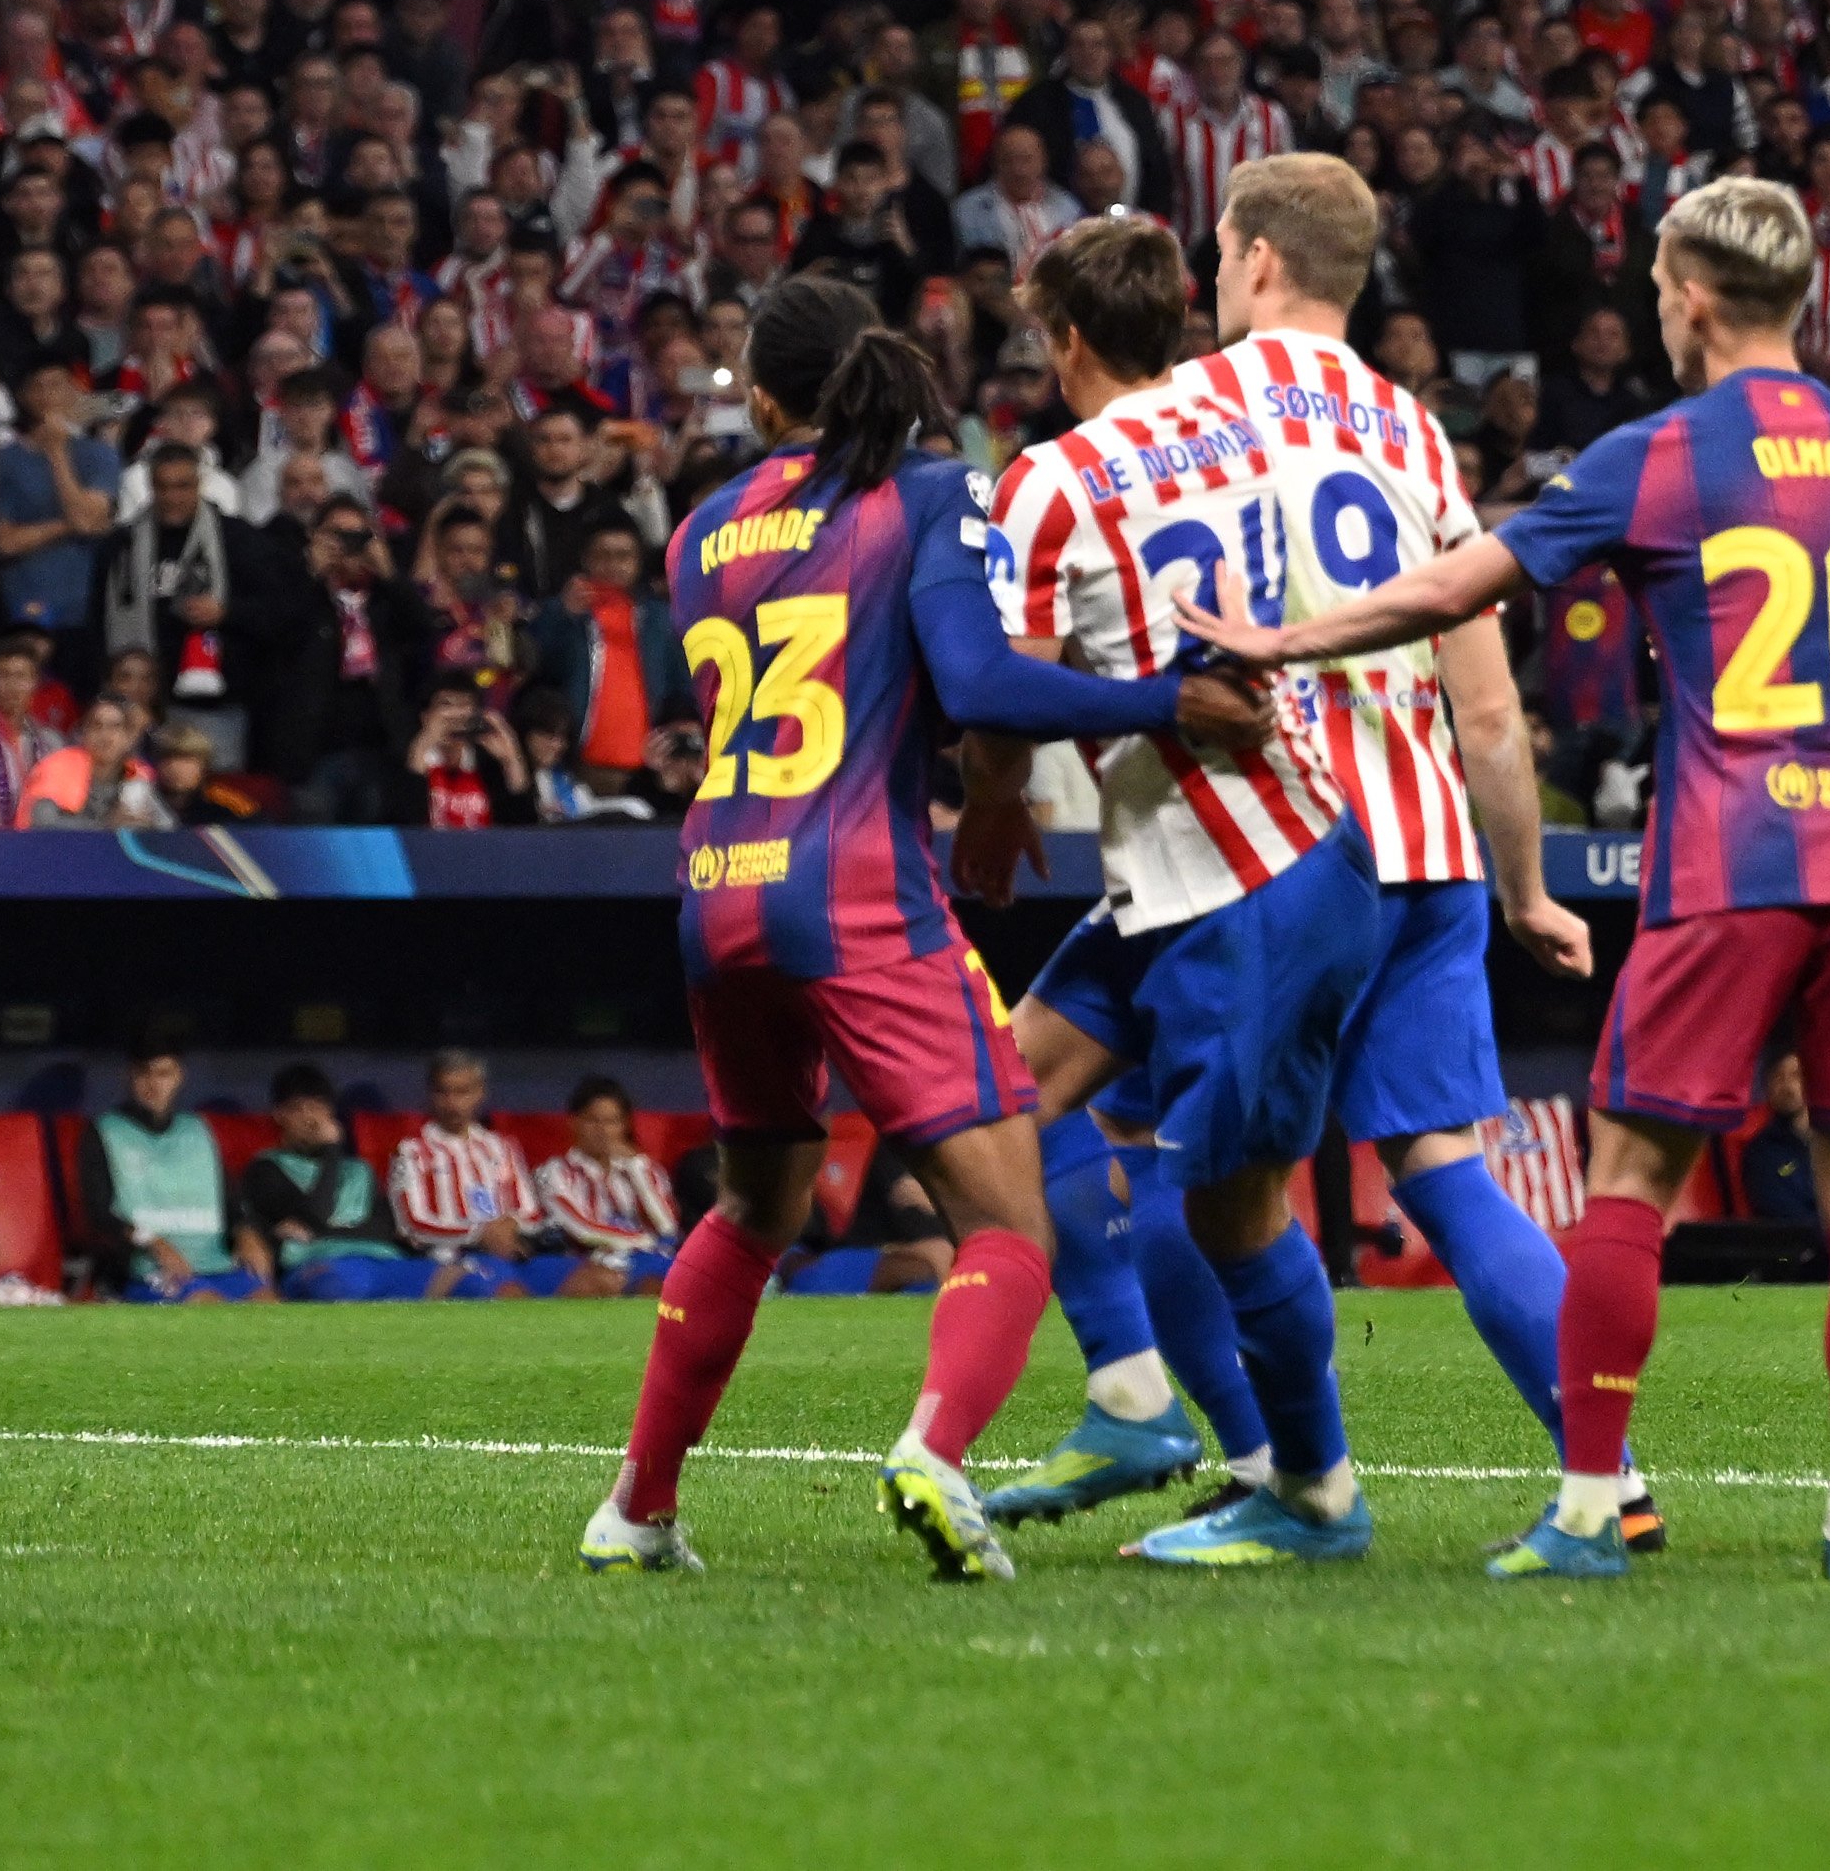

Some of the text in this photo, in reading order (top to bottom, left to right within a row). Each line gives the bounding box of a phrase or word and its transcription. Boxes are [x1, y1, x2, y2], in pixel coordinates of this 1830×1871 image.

[1263, 384, 1410, 448] SØRLOTH
[1079, 456, 1132, 503] LE
[682, 593, 847, 801] 23
[727, 838, 789, 862] UNHCR
